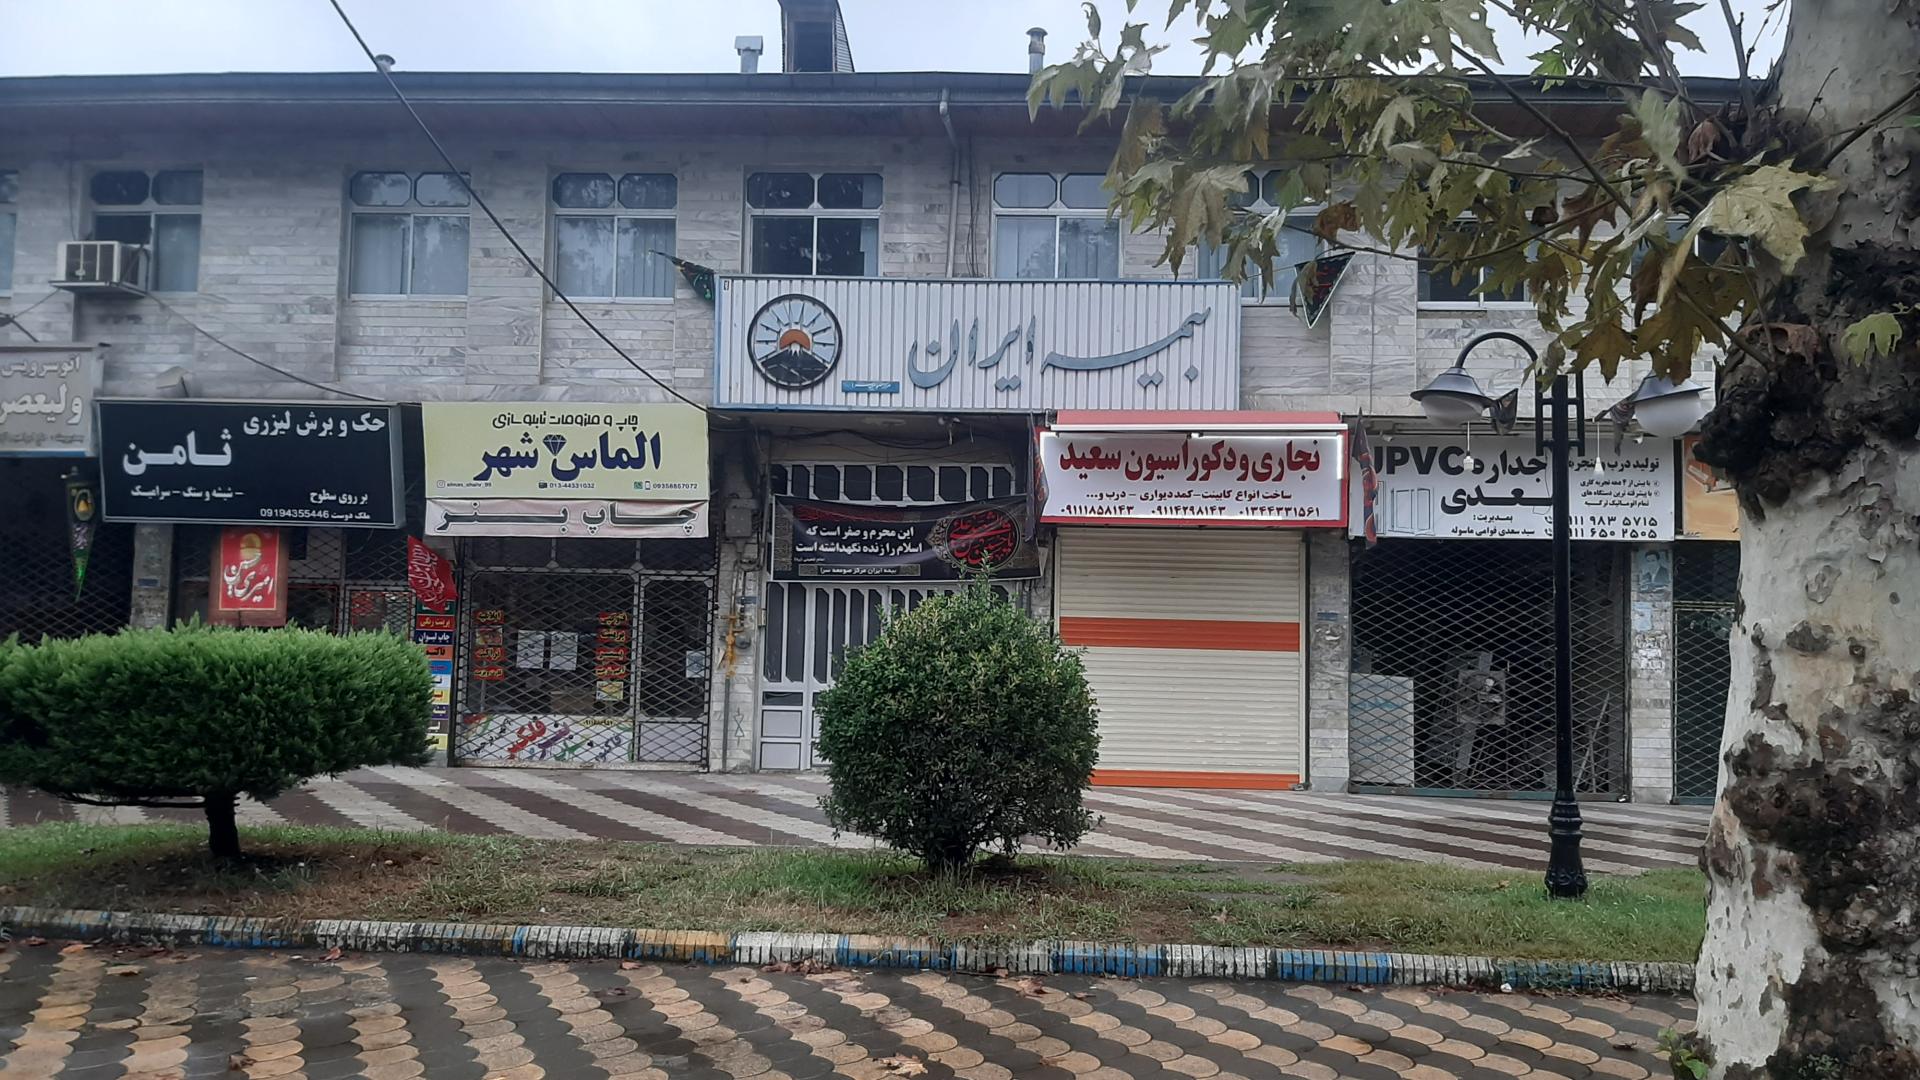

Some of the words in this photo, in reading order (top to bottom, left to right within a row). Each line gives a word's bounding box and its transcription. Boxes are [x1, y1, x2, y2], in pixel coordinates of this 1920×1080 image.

[908, 315, 1035, 389] ایران
[1041, 306, 1211, 387] بیمه
[243, 410, 291, 435] لیزری
[296, 411, 333, 436] برش
[351, 412, 386, 431] حک
[550, 413, 600, 427] ملزومات
[604, 414, 613, 427] و
[616, 415, 639, 432] چاپ
[338, 419, 348, 437] و
[123, 428, 232, 475] ثامن
[473, 431, 539, 481] شهر
[551, 431, 662, 481] الماس
[1060, 442, 1122, 480] سعید
[1125, 438, 1236, 482] دکوراسیون
[1237, 453, 1249, 481] و
[1252, 440, 1320, 482] نجاری
[1472, 450, 1548, 483] جداره
[1607, 459, 1631, 472] درب
[1633, 457, 1660, 472] تولید
[131, 485, 171, 500] سرامیک
[182, 486, 203, 497] سنگ
[204, 490, 210, 501] و
[309, 489, 337, 503] سطوح
[338, 493, 357, 504] روی
[359, 493, 369, 504] بر
[1105, 490, 1126, 501] درب
[1139, 489, 1173, 501] دیواری
[1235, 489, 1260, 501] انواع
[1262, 490, 1292, 499] ساخت
[1441, 486, 1553, 515] عدی
[260, 508, 330, 518] 09194355446
[331, 512, 353, 521] دوست
[436, 501, 569, 534] بنر
[581, 501, 699, 536] چاپ
[1590, 515, 1617, 526] ۹۸۳
[1622, 516, 1658, 526] ۵۷۱۵
[805, 525, 819, 536] که
[820, 526, 841, 536] است
[842, 525, 861, 540] صفر
[862, 530, 869, 540] و
[869, 527, 896, 540] محرم
[897, 526, 914, 540] این
[1499, 527, 1521, 537] سعدی
[1590, 528, 1616, 538] ۶۵۰
[1621, 528, 1658, 539] ۲۵۰۵
[795, 541, 818, 552] است
[862, 542, 885, 556] زنده
[886, 542, 896, 556] را
[897, 542, 923, 556] اسلام
[223, 552, 262, 598] حسین
[867, 567, 883, 575] ایران
